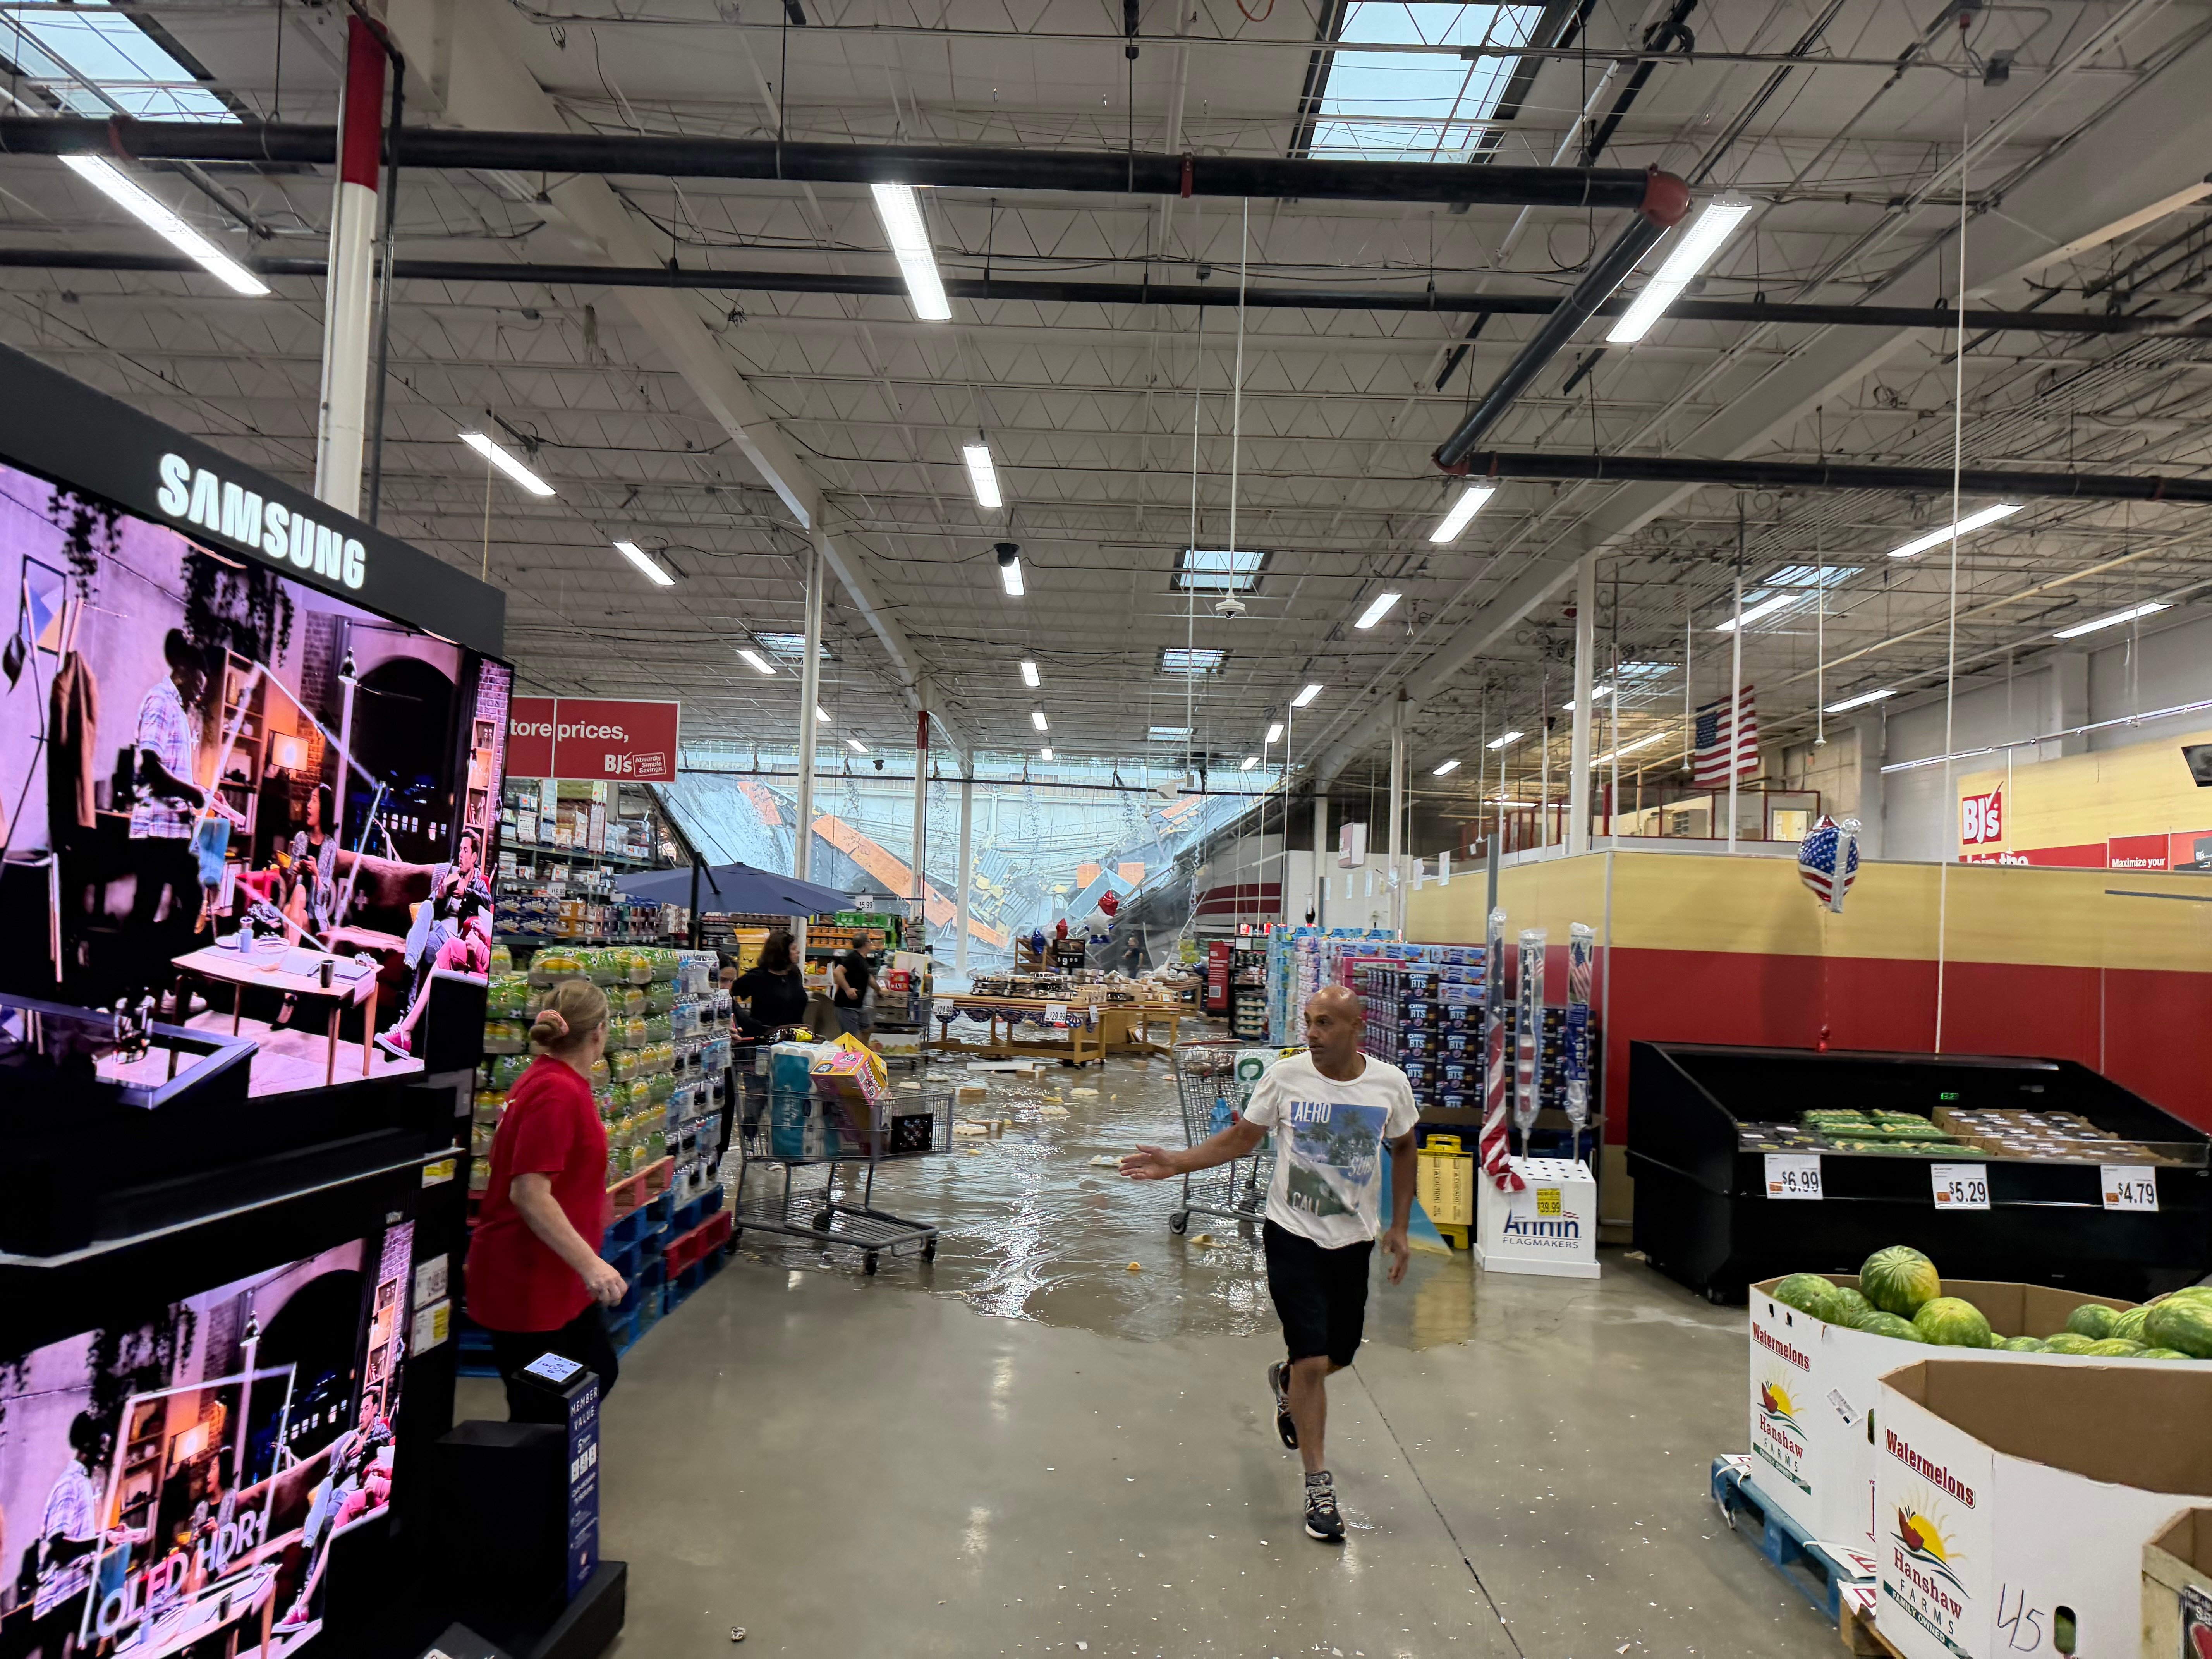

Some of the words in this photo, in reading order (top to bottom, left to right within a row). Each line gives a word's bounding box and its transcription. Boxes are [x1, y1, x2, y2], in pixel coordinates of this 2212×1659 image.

[158, 453, 365, 589] SAMSUNG
[557, 721, 629, 742] prices,
[605, 752, 632, 774] BJ's
[1963, 781, 2004, 843] BJ's
[2112, 857, 2146, 868] Maximize
[2148, 858, 2165, 868] your
[1050, 1012, 1065, 1021] $29.99
[1295, 1102, 1331, 1123] AERO
[1782, 1171, 1819, 1192] $6.99
[1949, 1181, 1986, 1202] $5.29
[2118, 1182, 2154, 1204] $4.79
[1503, 1237, 1578, 1249] FLAGMAKERS
[1753, 1322, 1810, 1370] Watermelons
[571, 1387, 598, 1417] MEMBER
[574, 1406, 596, 1431] VALUE
[1760, 1414, 1803, 1459] Hanshaw
[1764, 1438, 1798, 1472] FARMS
[1886, 1429, 1974, 1508] Watermelons
[97, 1552, 189, 1637] OLED
[195, 1510, 267, 1580] HDR+
[1894, 1547, 1962, 1619] Hanshaw
[1893, 1592, 1916, 1618] FAMILY
[1918, 1613, 1945, 1643] OWNED
[1900, 1579, 1954, 1635] FARMS
